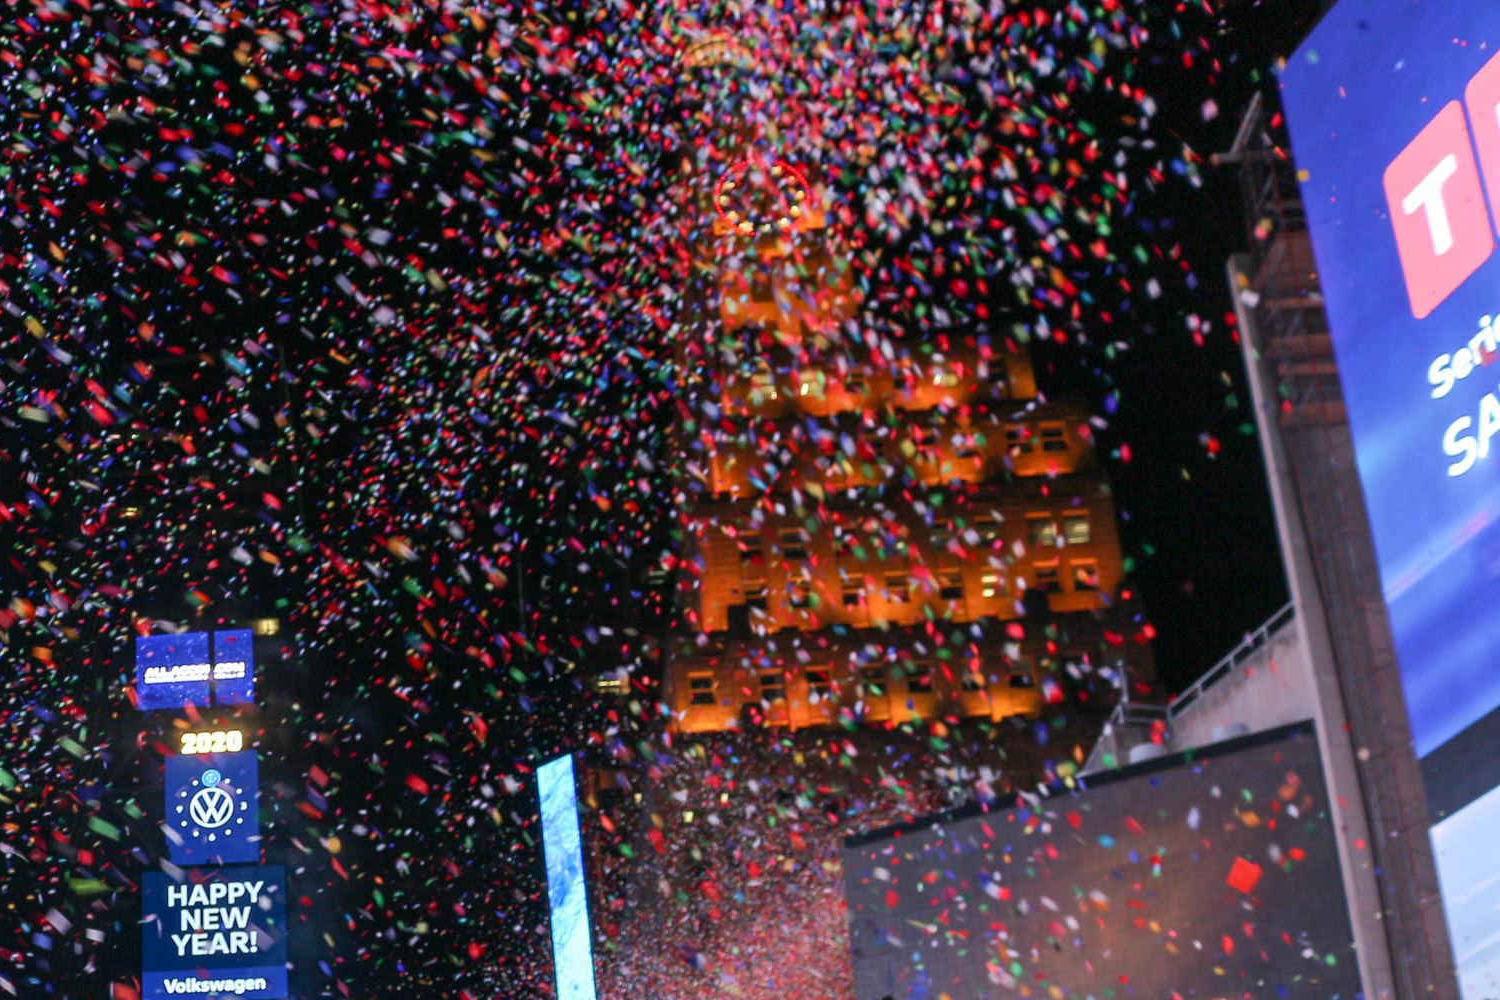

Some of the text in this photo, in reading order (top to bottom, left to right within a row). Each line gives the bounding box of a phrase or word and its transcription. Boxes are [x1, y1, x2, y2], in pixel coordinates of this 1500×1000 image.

[1427, 313, 1500, 399] Seri
[1442, 384, 1500, 477] SA
[181, 731, 242, 754] 2020
[167, 880, 264, 908] HAPPY
[180, 906, 252, 932] NEW
[171, 930, 259, 956] YEAR!
[163, 977, 267, 995] Volkswagen
